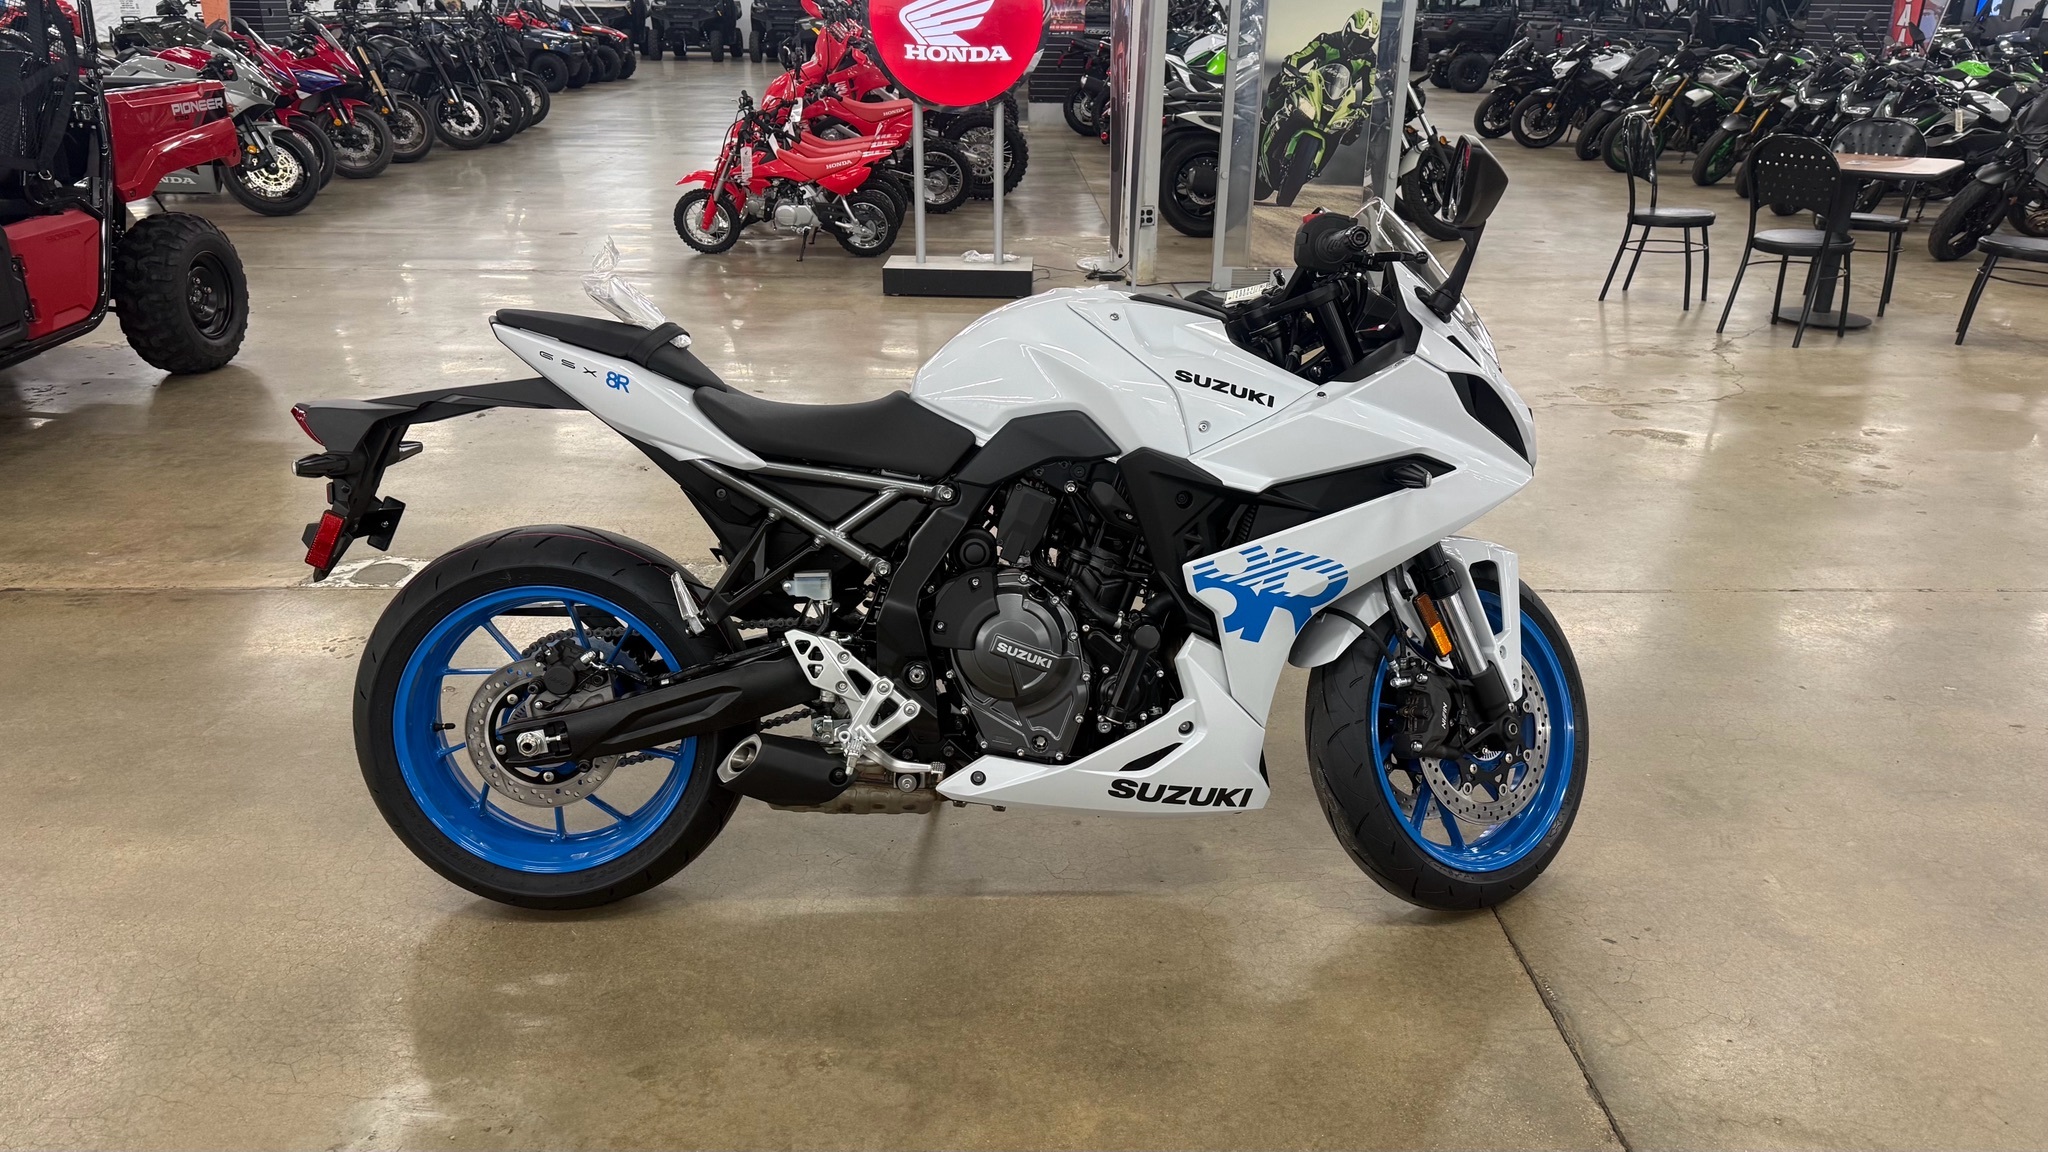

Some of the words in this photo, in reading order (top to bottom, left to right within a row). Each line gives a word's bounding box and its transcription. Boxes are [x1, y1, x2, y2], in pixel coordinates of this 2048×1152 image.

[904, 44, 1012, 62] HONDA
[171, 97, 224, 116] PIONEER
[883, 107, 905, 117] HONDA
[826, 160, 852, 169] HONDA
[159, 176, 196, 185] NDA
[605, 371, 630, 393] 8R
[1175, 369, 1275, 408] SUZUKI
[996, 641, 1053, 669] SUZUKI
[1108, 778, 1254, 807] SUZUKI
